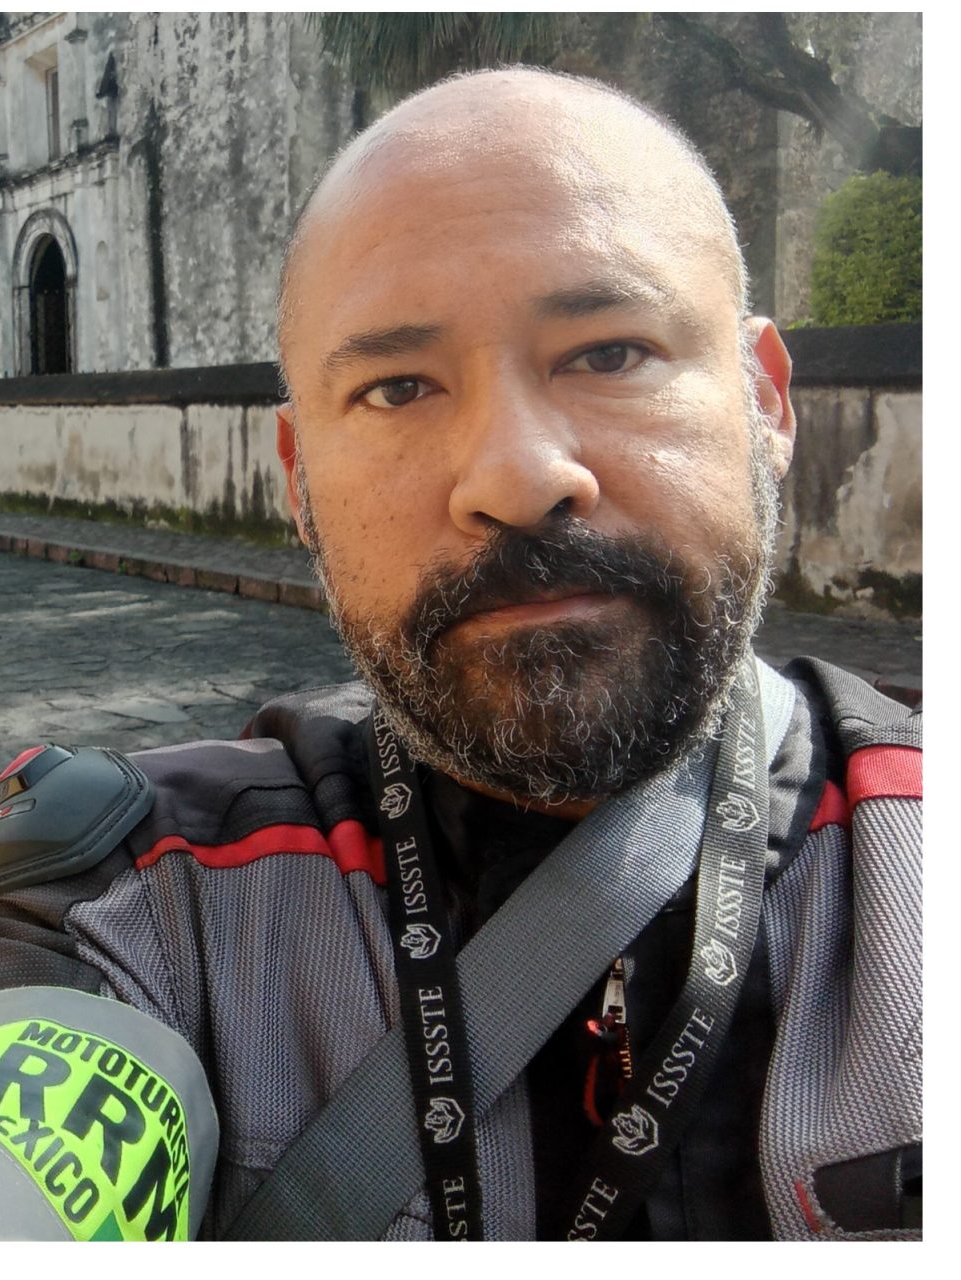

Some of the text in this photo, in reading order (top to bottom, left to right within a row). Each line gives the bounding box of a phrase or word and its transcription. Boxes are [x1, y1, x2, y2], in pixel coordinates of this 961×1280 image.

[733, 712, 756, 789] ISSSTE
[396, 836, 428, 915] ISSSTE
[715, 855, 746, 940] ISSSTE
[419, 986, 454, 1086] ISSSTE
[646, 1007, 715, 1109] ISSSTE
